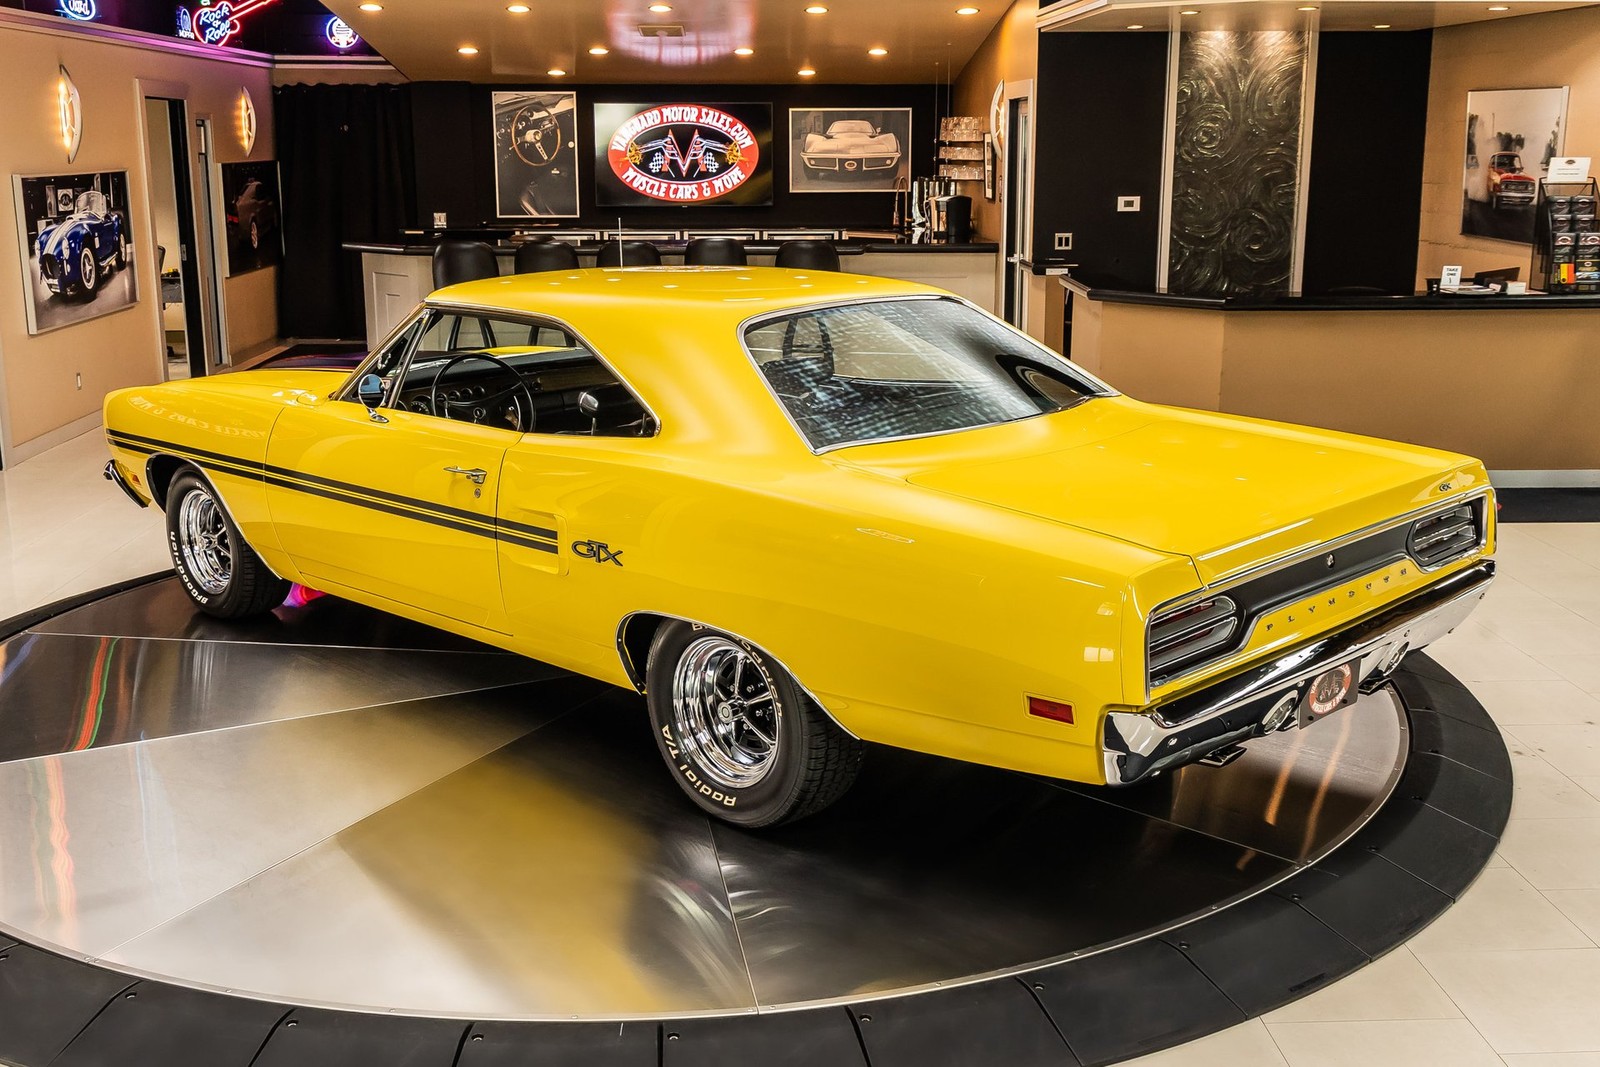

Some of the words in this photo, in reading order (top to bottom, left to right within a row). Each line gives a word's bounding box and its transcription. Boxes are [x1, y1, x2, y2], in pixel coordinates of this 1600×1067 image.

[199, 5, 230, 26] Rock
[204, 19, 231, 44] Roll
[611, 109, 662, 152] VANGUARD
[661, 106, 699, 123] MOTOR
[621, 166, 669, 198] MUSCLE
[669, 183, 699, 200] CARS
[701, 181, 712, 198] &
[711, 165, 746, 194] MORE
[170, 531, 209, 605] BFGoodrich
[571, 539, 624, 568] GTX
[1264, 567, 1408, 633] PLYMOUTH
[661, 723, 681, 761] T/A
[678, 764, 738, 808] Radial
